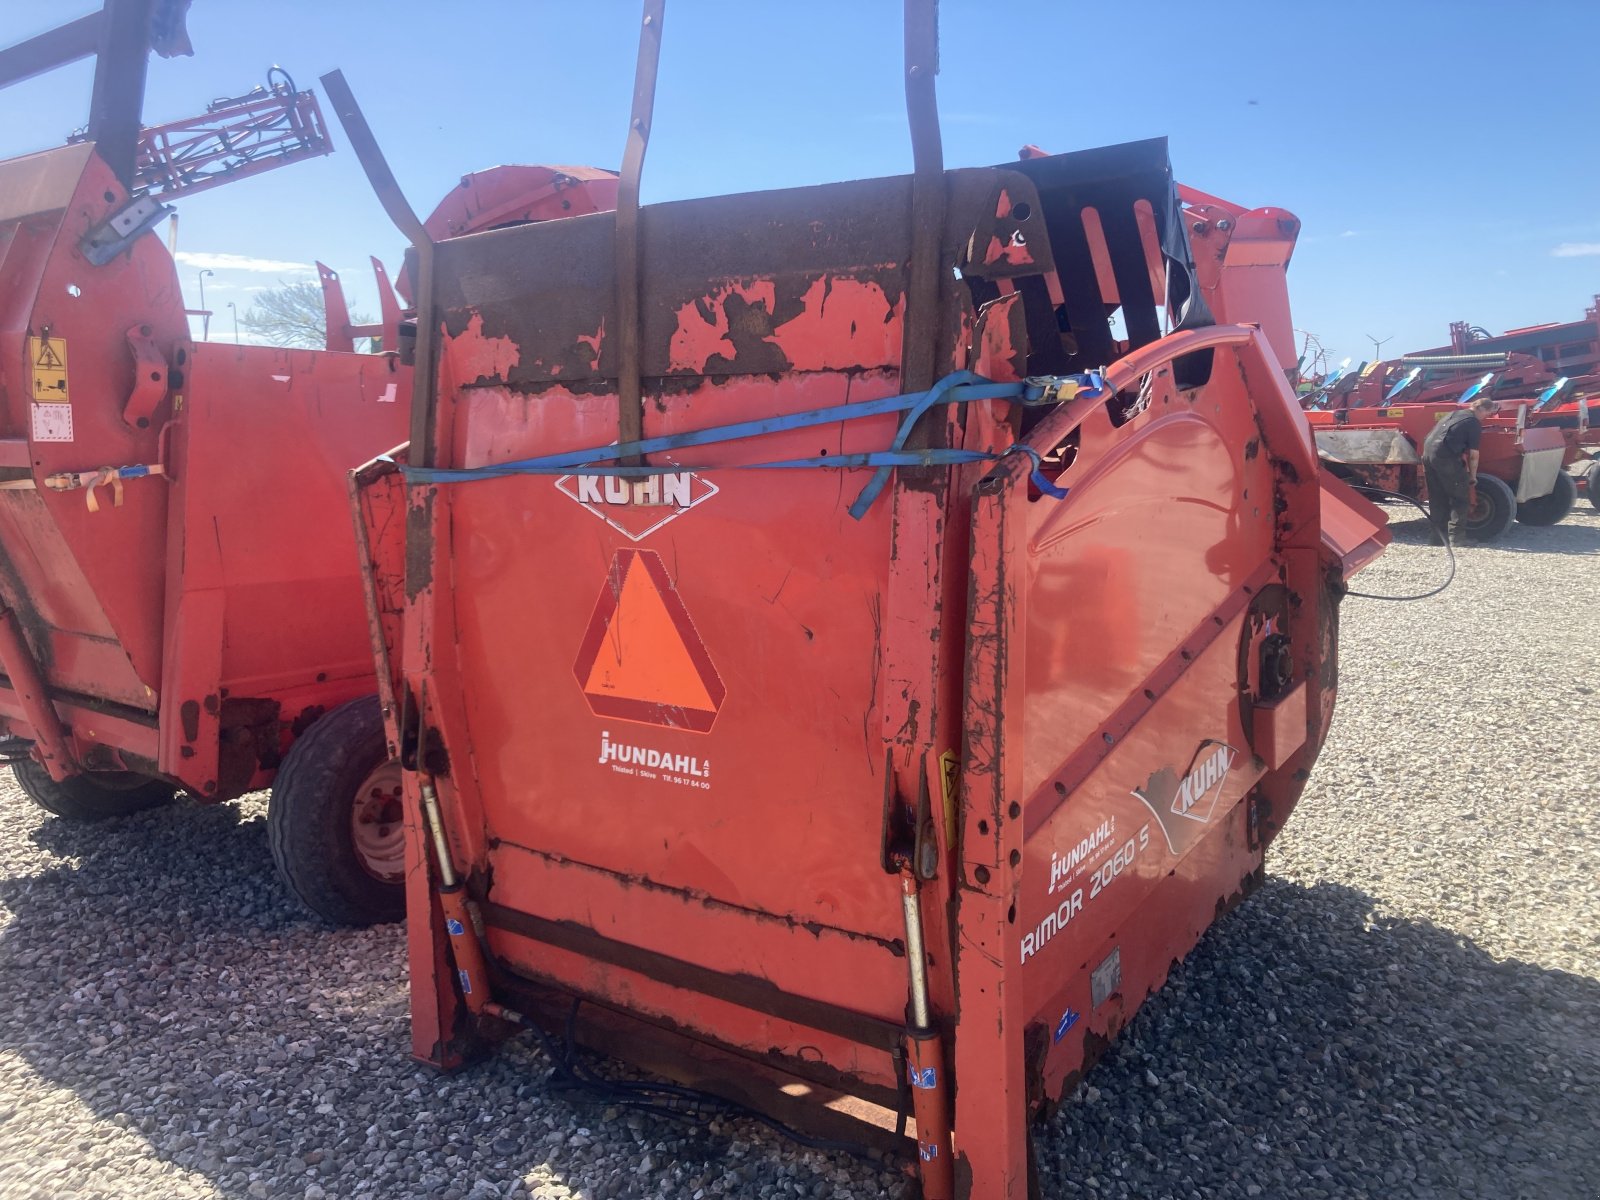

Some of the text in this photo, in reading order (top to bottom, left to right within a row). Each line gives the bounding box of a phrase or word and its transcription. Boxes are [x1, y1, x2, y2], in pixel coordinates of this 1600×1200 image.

[578, 473, 691, 508] KUHN
[640, 770, 657, 779] Skive
[1181, 746, 1229, 814] KUHN
[1089, 838, 1136, 900] 2060
[1139, 823, 1150, 852] S
